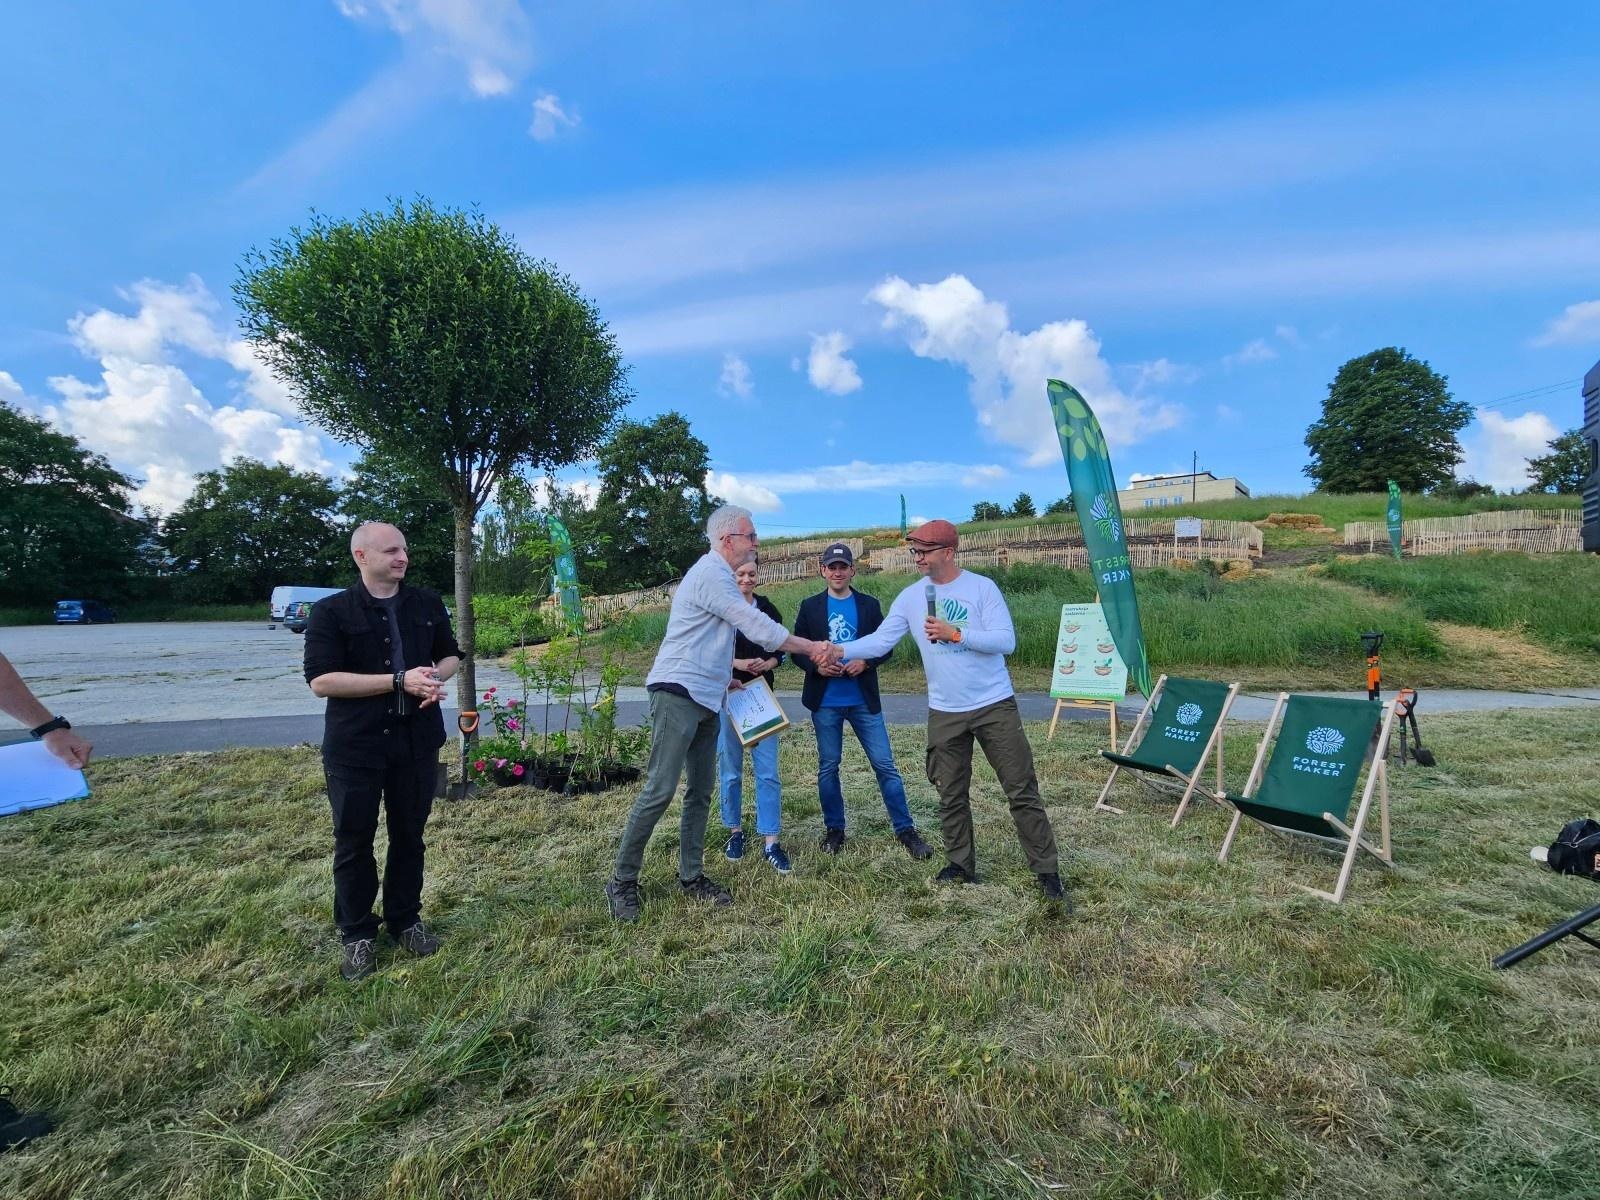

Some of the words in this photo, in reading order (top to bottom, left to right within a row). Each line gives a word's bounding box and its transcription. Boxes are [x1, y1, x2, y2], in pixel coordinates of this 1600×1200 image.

[1165, 726, 1200, 736] FOREST
[1165, 732, 1196, 742] MAKER
[1293, 756, 1345, 769] FOREST
[1294, 764, 1340, 776] MAKER
